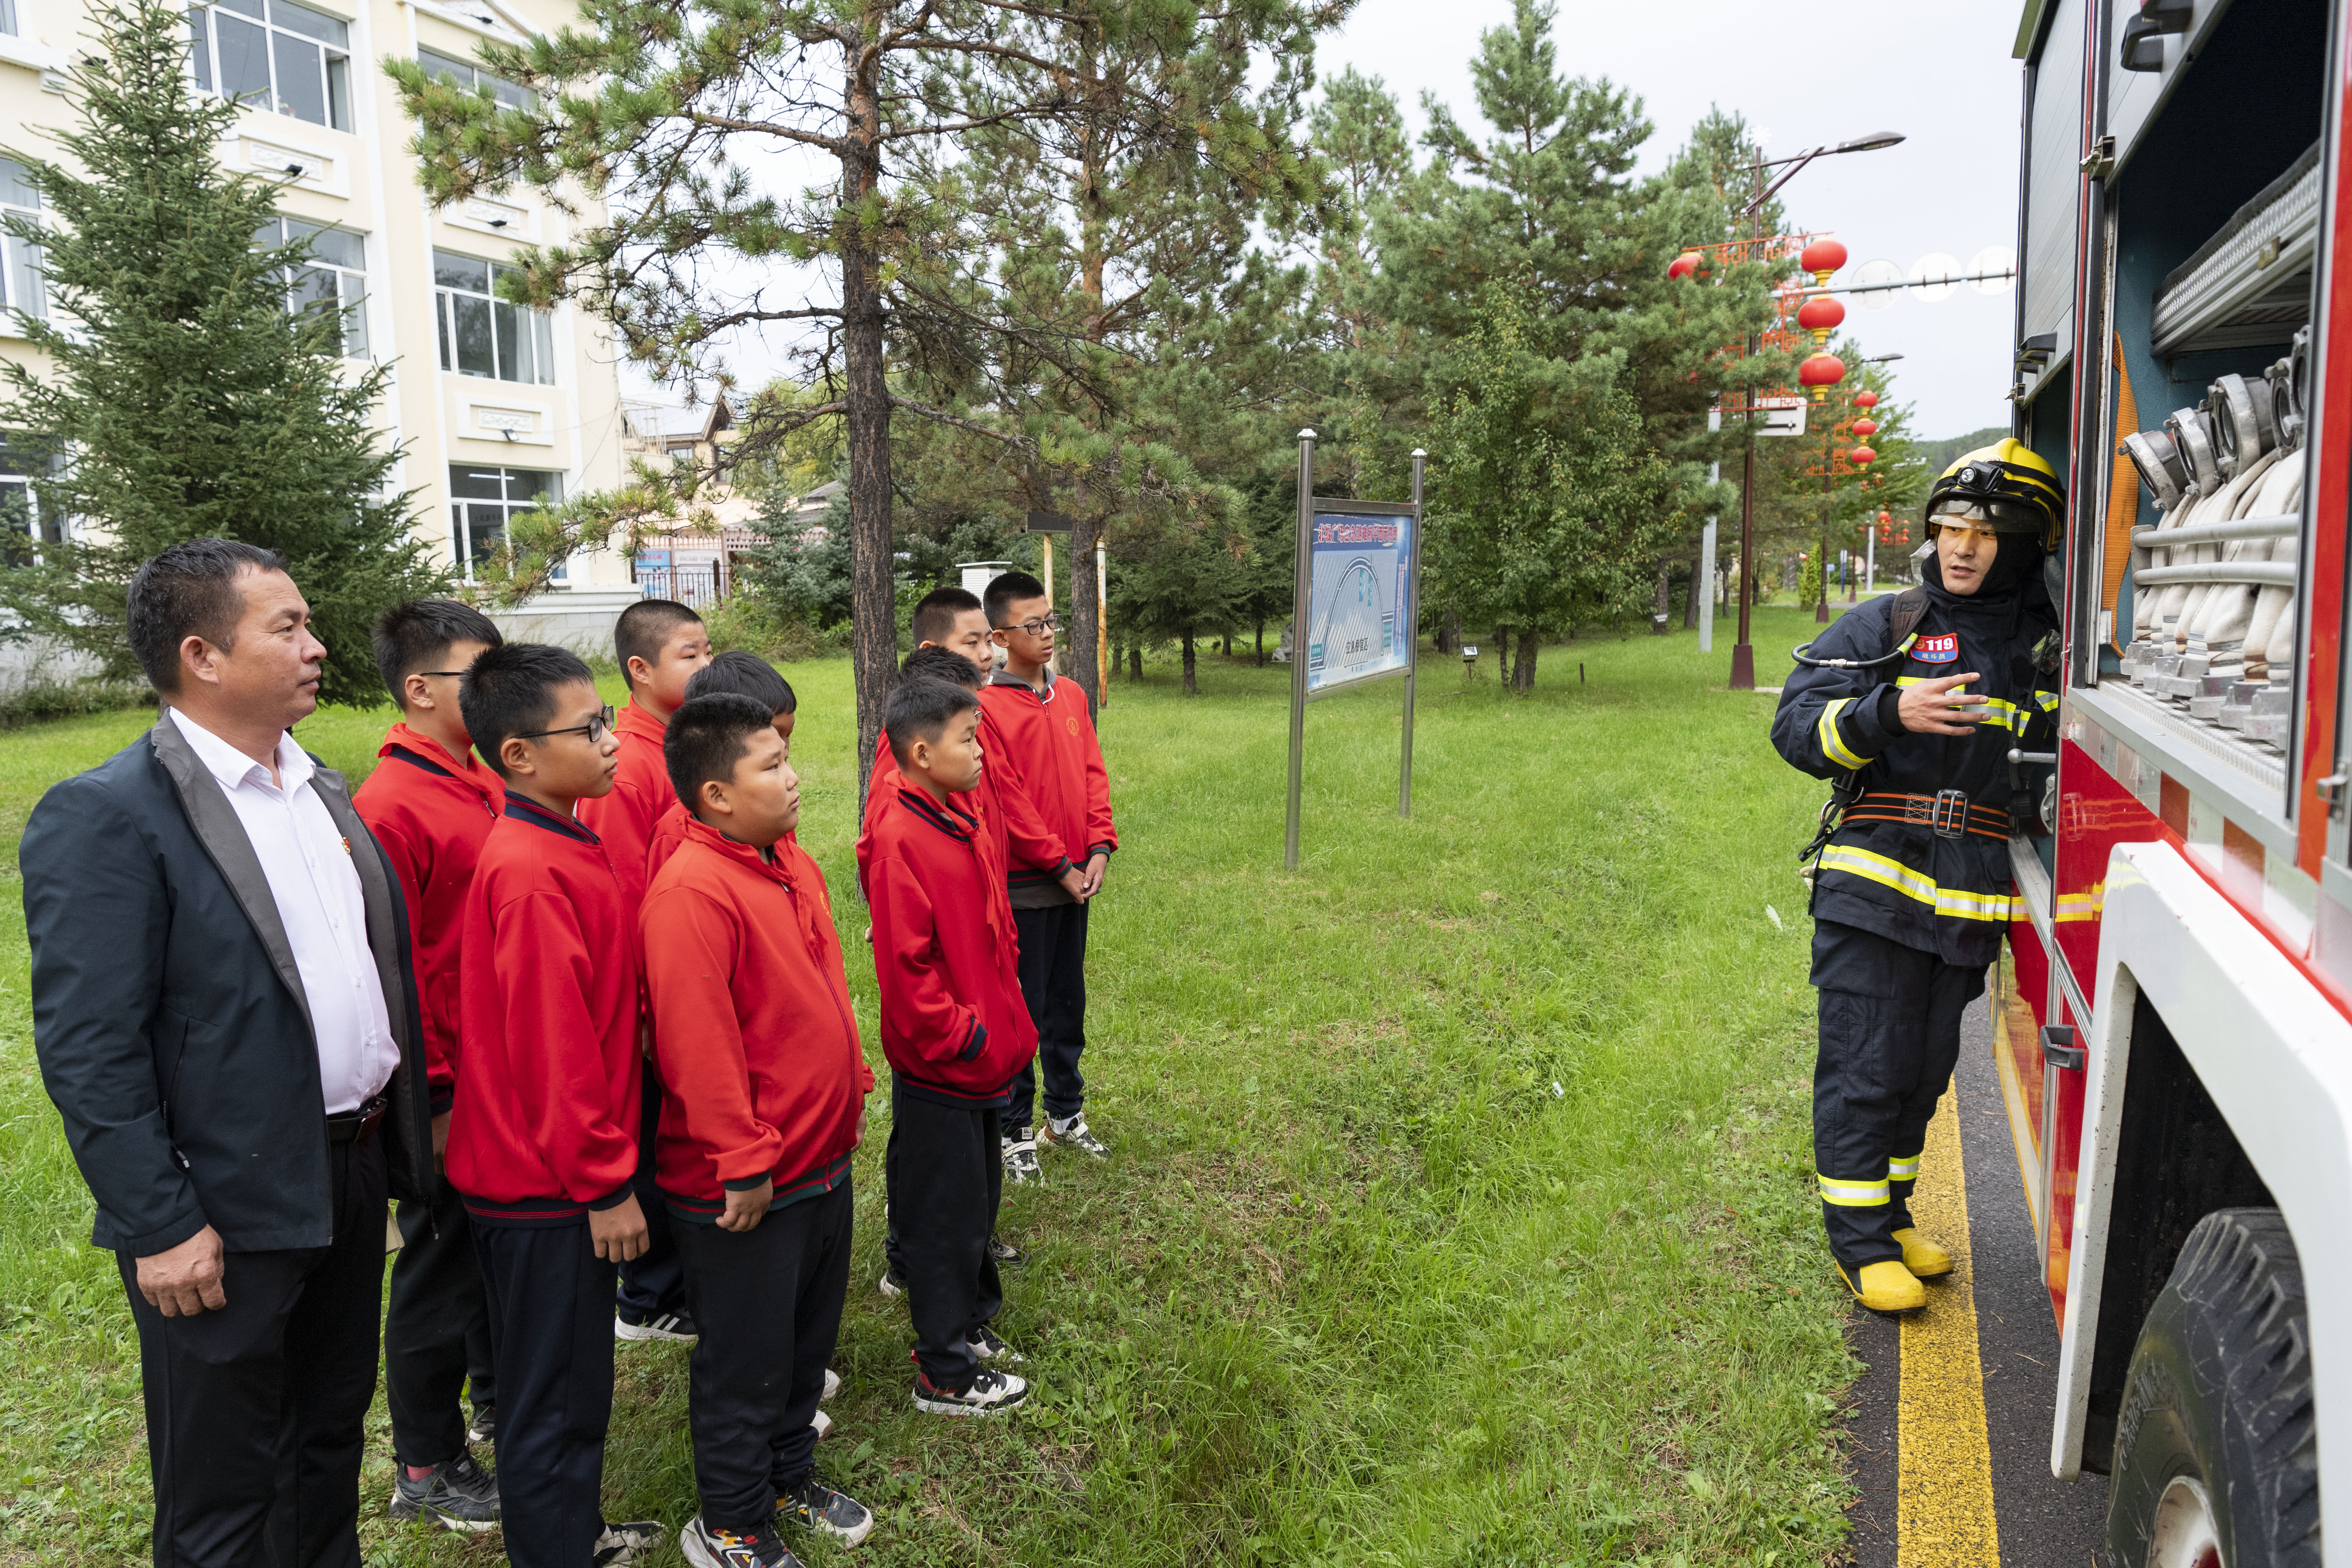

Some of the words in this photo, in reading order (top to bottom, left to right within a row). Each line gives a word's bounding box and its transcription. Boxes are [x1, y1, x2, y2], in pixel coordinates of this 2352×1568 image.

[1318, 523, 1398, 543] 北极广场应急避难所平面示意图
[1926, 637, 1953, 651] 119
